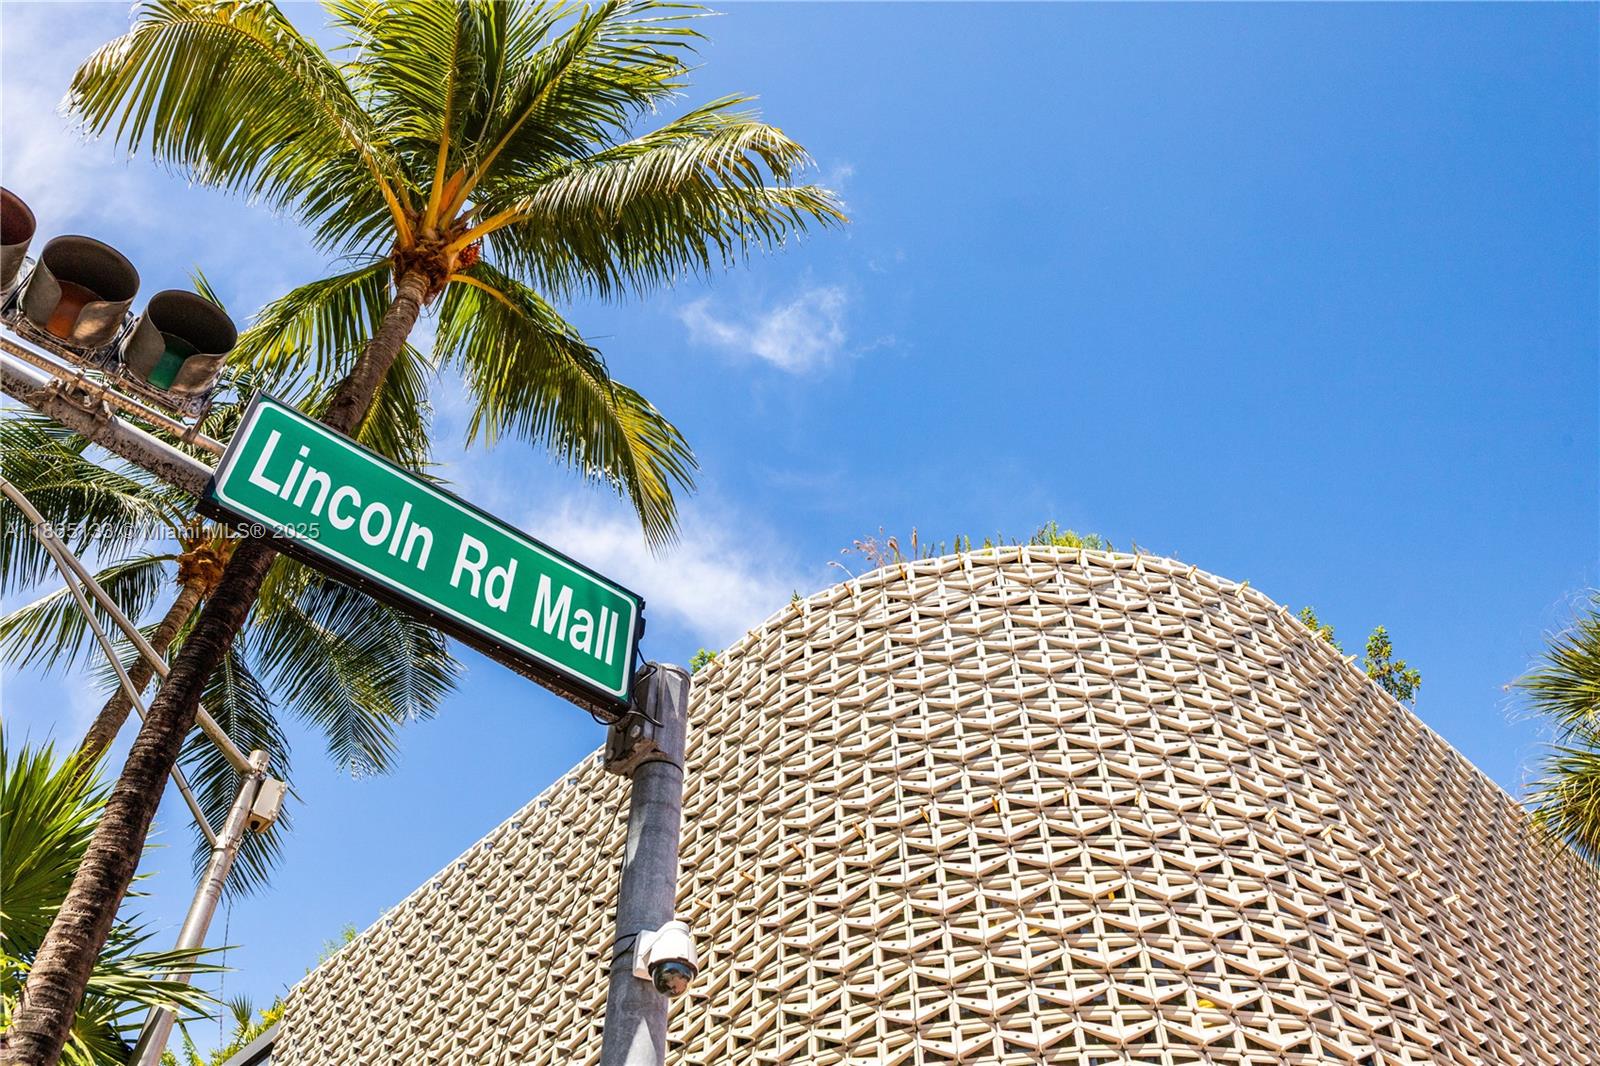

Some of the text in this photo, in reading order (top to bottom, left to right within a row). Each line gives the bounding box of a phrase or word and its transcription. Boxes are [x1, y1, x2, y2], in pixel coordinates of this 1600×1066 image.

[248, 429, 619, 666] Lincoln Rd Mall
